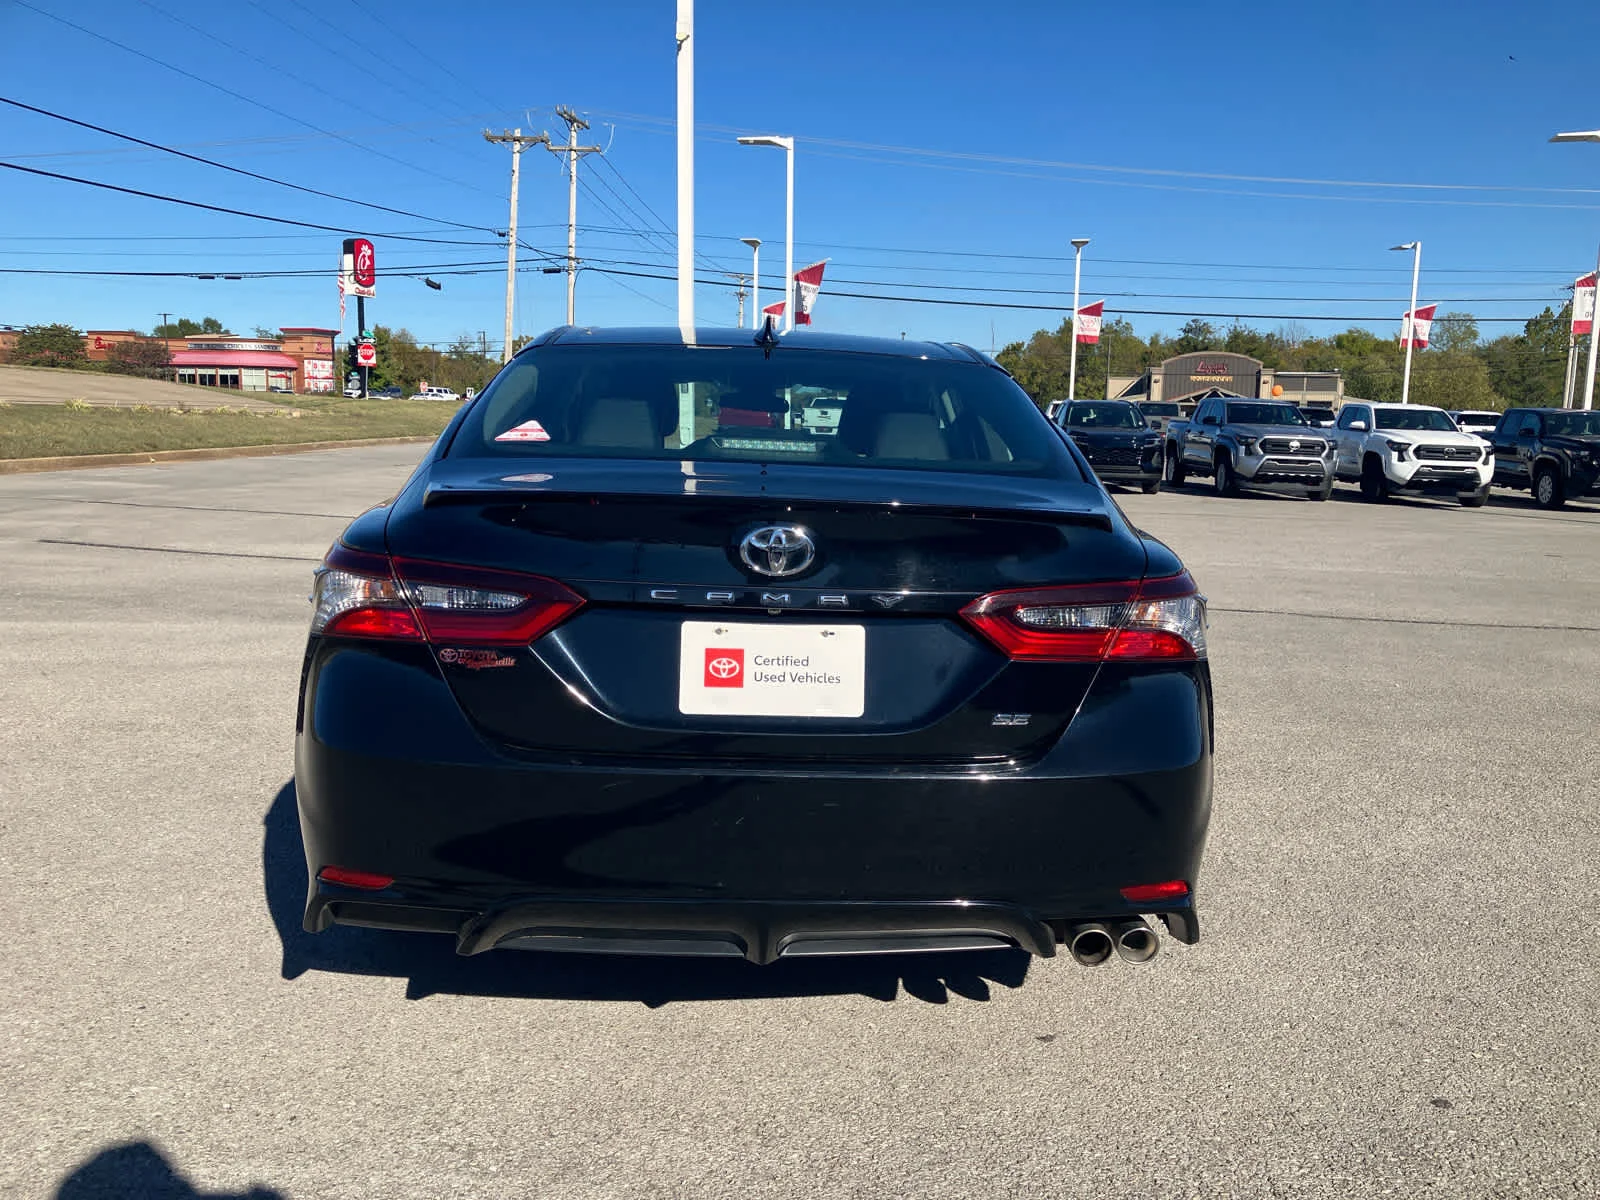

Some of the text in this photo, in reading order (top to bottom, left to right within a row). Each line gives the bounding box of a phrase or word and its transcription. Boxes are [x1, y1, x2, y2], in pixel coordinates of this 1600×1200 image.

[360, 348, 375, 356] STOP
[650, 588, 905, 609] CAMRY
[458, 649, 497, 660] TOYOTA
[753, 655, 810, 667] Certified
[753, 671, 841, 684] Used Vehicles
[991, 713, 1032, 726] SE
